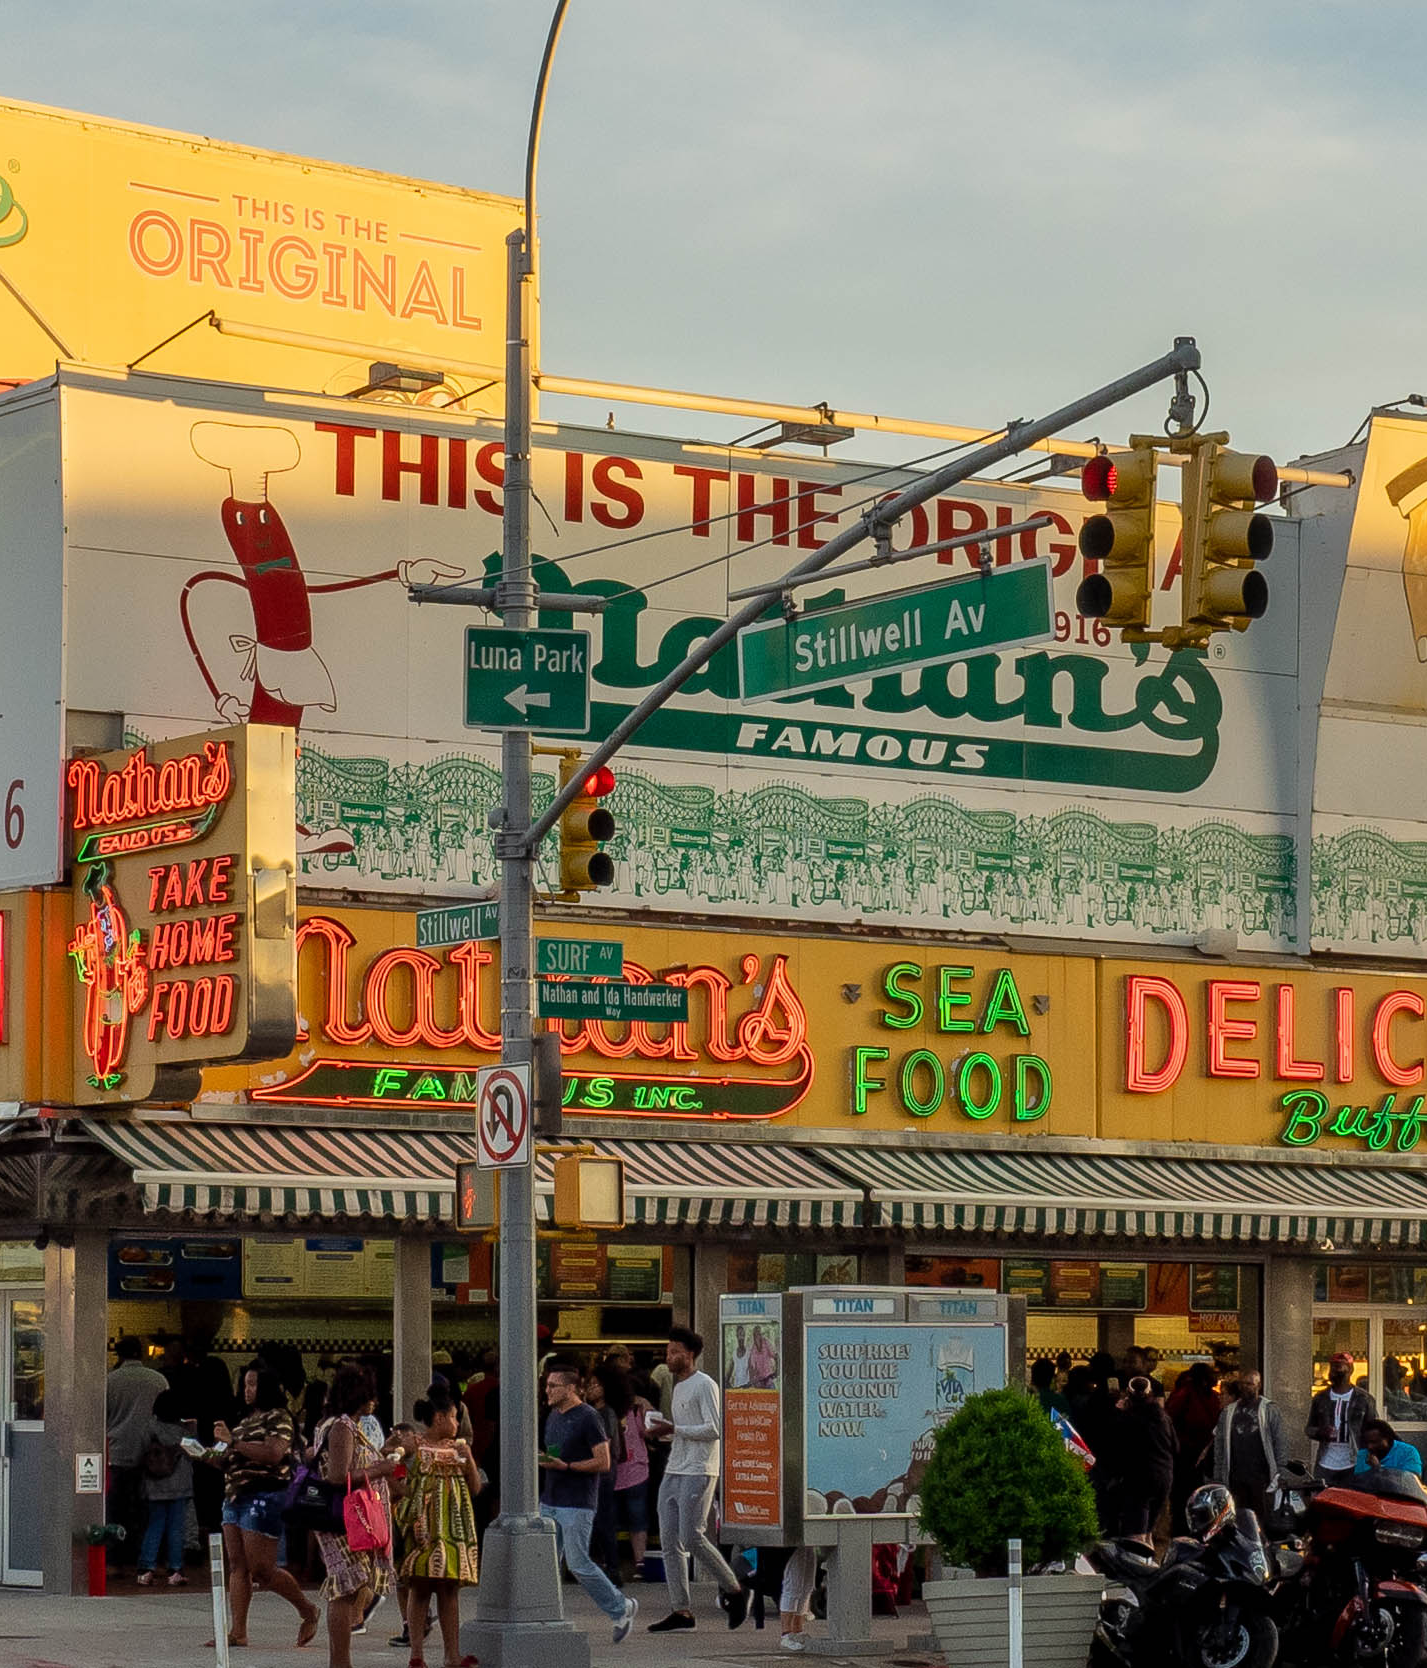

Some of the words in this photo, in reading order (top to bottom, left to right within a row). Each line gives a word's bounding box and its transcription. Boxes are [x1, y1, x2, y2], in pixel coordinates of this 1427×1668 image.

[232, 194, 295, 226] THIS
[303, 207, 326, 231] IS
[338, 213, 389, 244] THE
[129, 209, 483, 331] ORIGINAL
[314, 421, 505, 517] THIS
[565, 450, 646, 530] IS
[673, 464, 844, 550] THE
[794, 606, 924, 673] Stillwell
[944, 600, 987, 641] Av
[1055, 611, 1111, 648] 916
[469, 642, 522, 672] Luna
[534, 644, 584, 675] Park
[735, 723, 990, 771] FAMOUS
[68, 741, 231, 829] Nathan's
[98, 825, 176, 854] FAMOUS
[148, 856, 233, 912] TAKE
[149, 913, 238, 970] HOME
[419, 907, 482, 945] Stillwell
[546, 943, 592, 973] SURF
[147, 974, 234, 1043] FOOD
[542, 985, 578, 1005] Nathan
[581, 986, 600, 1005] and
[603, 986, 620, 1006] Ida
[623, 987, 683, 1009] Handwerker
[880, 961, 1032, 1037] SEA
[633, 1086, 704, 1110] INC.
[852, 1045, 1053, 1121] FOOD
[737, 1300, 766, 1315] TITAN
[832, 1298, 874, 1313] TITAN
[940, 1300, 977, 1315] TITAN
[818, 1343, 911, 1361] SURPRISE!
[818, 1363, 859, 1380] YOU
[859, 1363, 900, 1380] LIKE
[818, 1381, 902, 1399] COCONUT
[818, 1421, 866, 1438] NOW.
